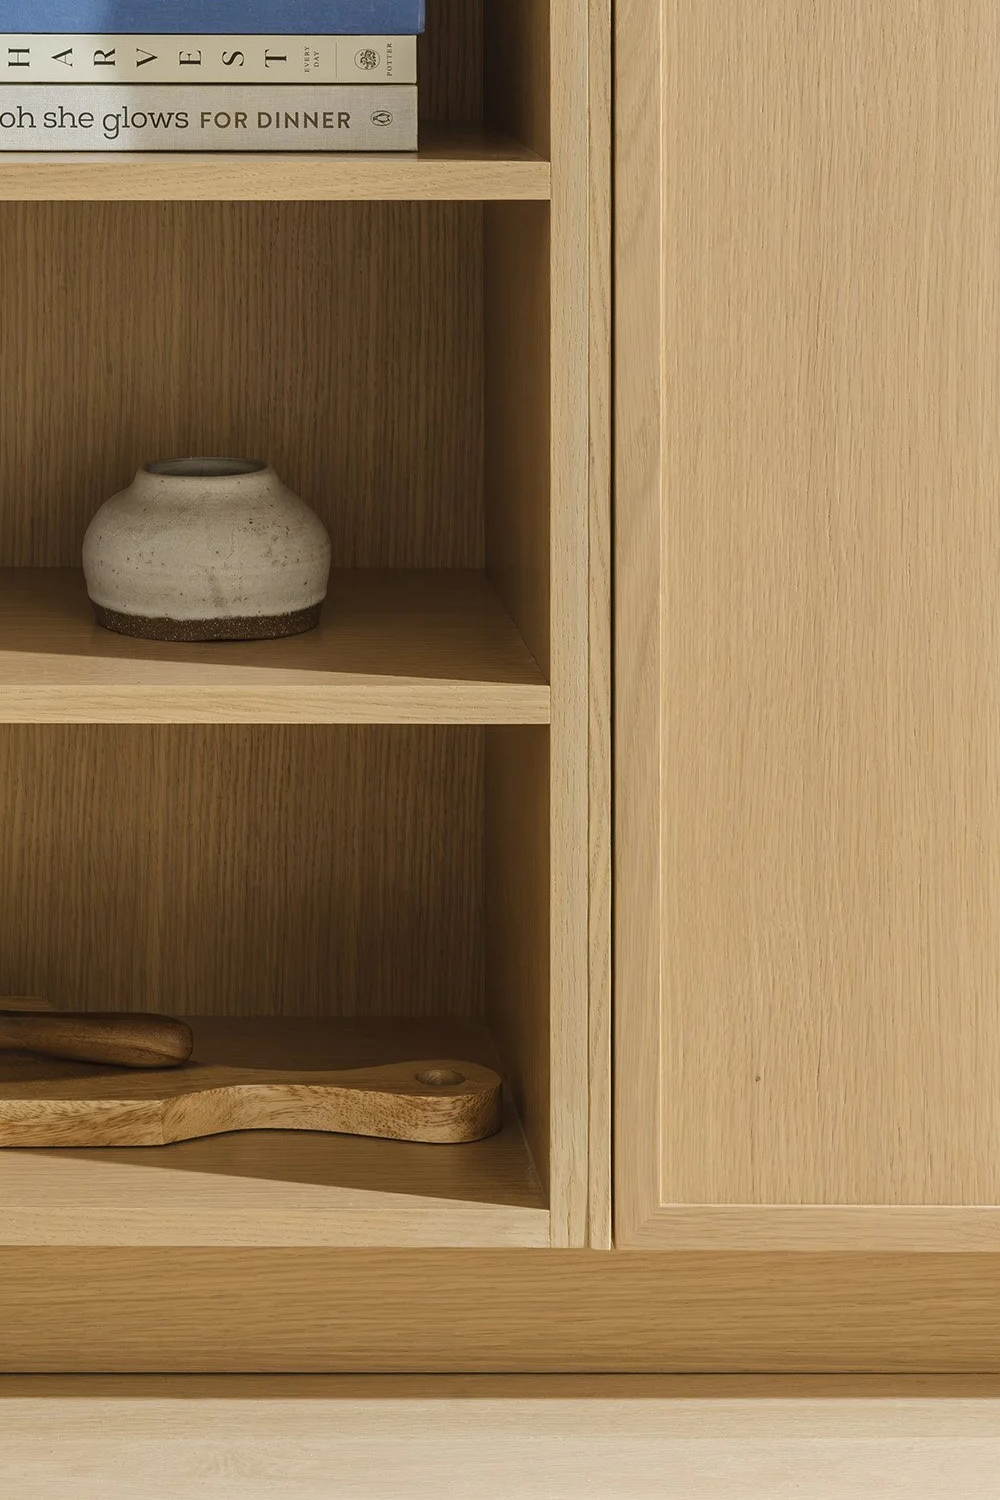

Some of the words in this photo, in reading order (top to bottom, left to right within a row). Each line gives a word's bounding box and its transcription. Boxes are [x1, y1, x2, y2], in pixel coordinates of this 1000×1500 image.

[7, 47, 288, 68] HARVEST
[0, 105, 37, 129] oh
[42, 105, 95, 129] she
[102, 105, 190, 140] glows
[200, 111, 248, 129] FOR
[257, 111, 351, 129] DINNER
